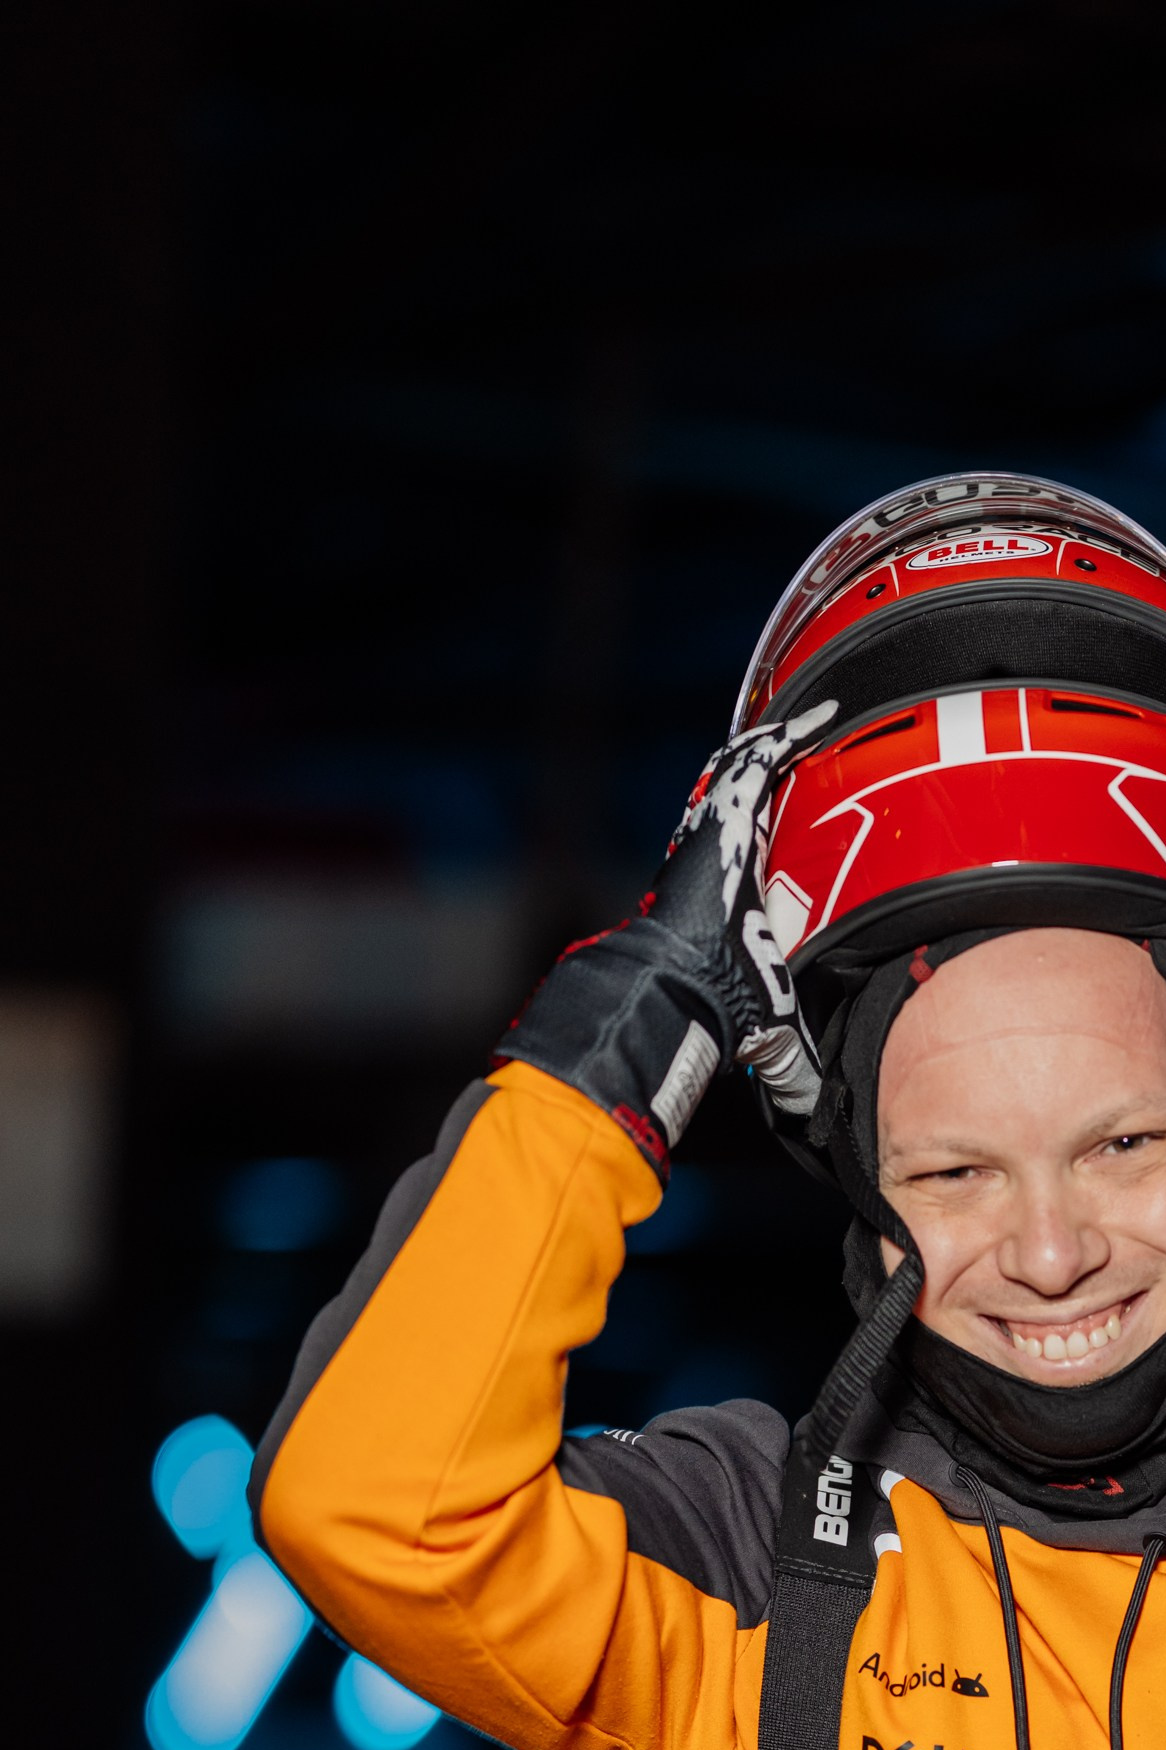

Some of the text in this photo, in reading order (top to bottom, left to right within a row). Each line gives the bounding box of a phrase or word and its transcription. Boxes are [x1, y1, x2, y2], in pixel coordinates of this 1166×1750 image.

[927, 539, 1029, 562] BELL
[939, 550, 1015, 563] HELMETS
[858, 1651, 945, 1698] Android
